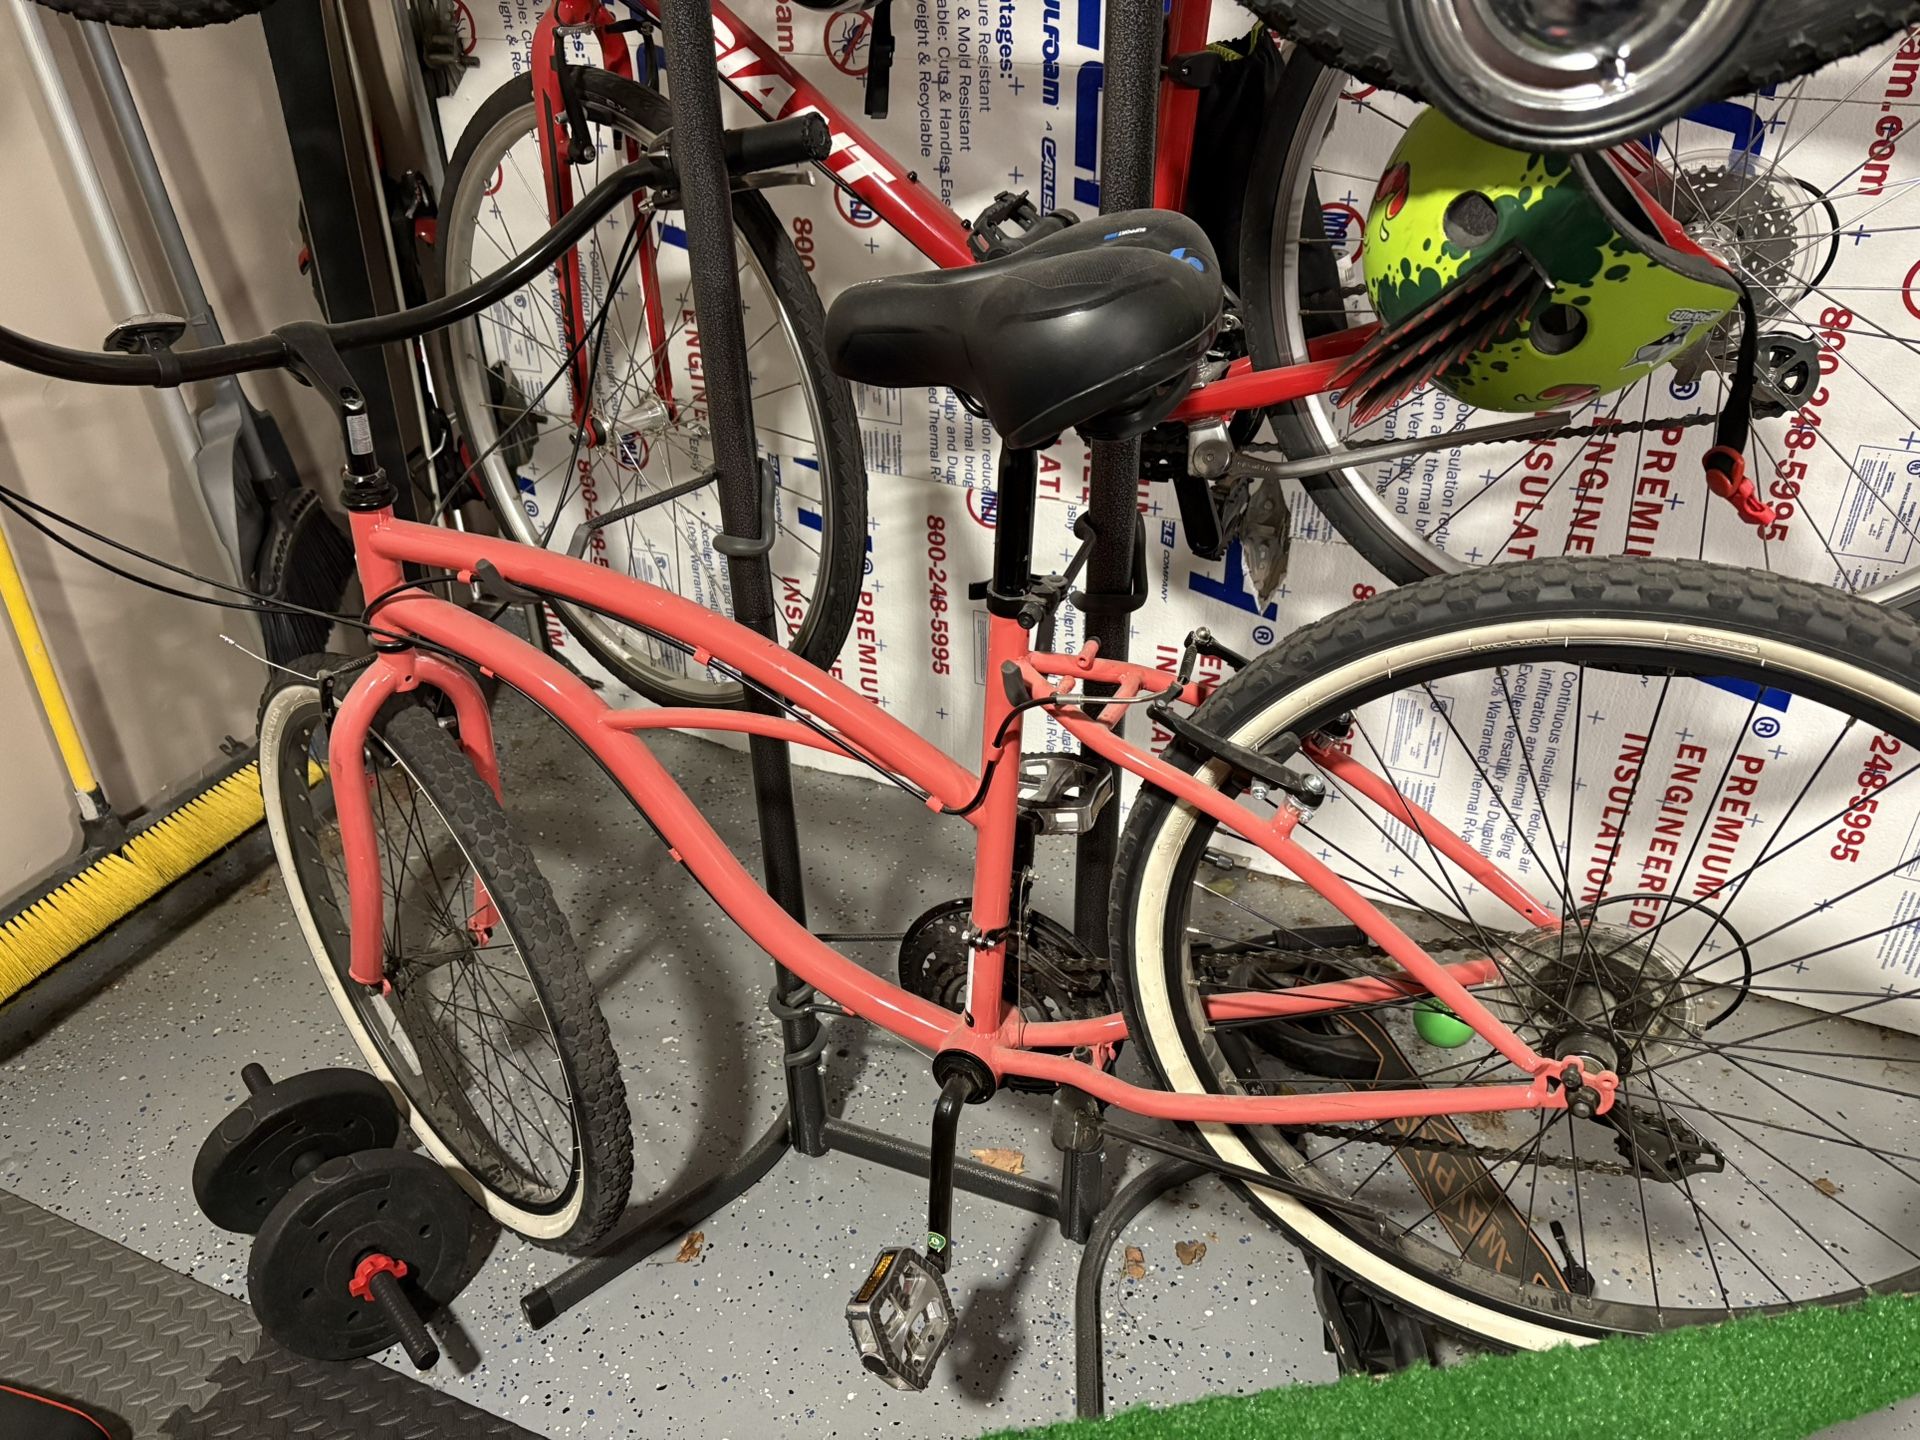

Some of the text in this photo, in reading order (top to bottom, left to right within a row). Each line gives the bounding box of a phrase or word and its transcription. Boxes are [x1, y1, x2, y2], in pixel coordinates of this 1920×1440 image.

[937, 47, 951, 85] Cuts
[957, 26, 971, 69] Mold
[995, 0, 1016, 79] tages:
[914, 0, 933, 157] eight & Recyclable
[939, 91, 952, 103] &
[978, 33, 992, 113] Resistant
[939, 108, 952, 174] Handles
[959, 75, 972, 153] Resistant
[928, 404, 942, 463] Thermal
[946, 424, 957, 449] and
[1757, 306, 1853, 541] 800248-5995
[1396, 487, 1409, 515] and
[1421, 460, 1439, 515] thermal
[1507, 412, 1556, 560] SULAT
[690, 553, 704, 606] Warrante
[927, 515, 950, 675] 800-248-5995
[1160, 550, 1172, 603] COMPANY
[1508, 664, 1533, 720] Excellent
[1524, 668, 1555, 738] infiltration
[1548, 671, 1578, 744] Continuous
[1477, 701, 1503, 765] Warranted
[1492, 719, 1517, 783] Versatility
[1496, 814, 1519, 861] bidging
[1580, 733, 1649, 904] INSULATION
[1629, 743, 1708, 928] ENGINEERED
[1692, 754, 1765, 900] PREMIUM
[1518, 857, 1531, 874] air
